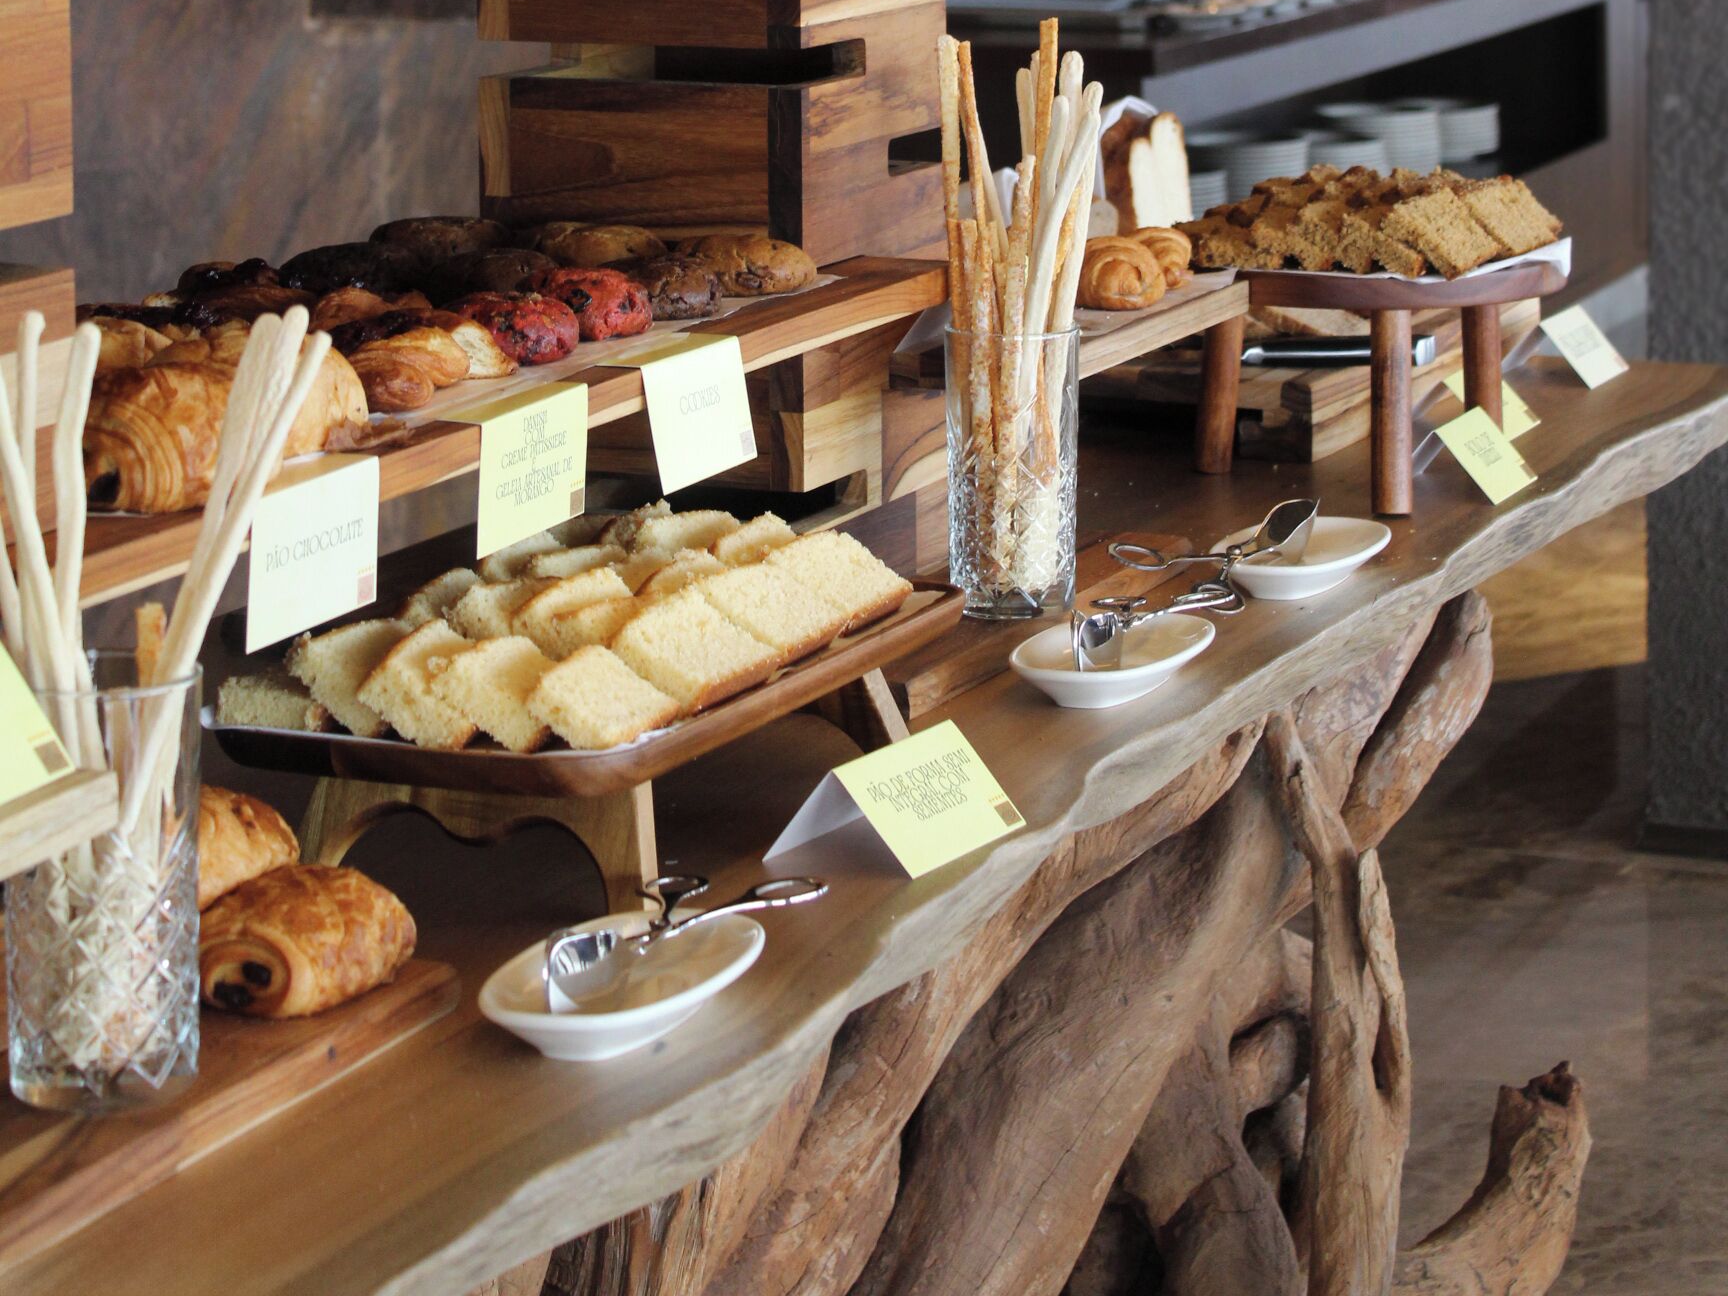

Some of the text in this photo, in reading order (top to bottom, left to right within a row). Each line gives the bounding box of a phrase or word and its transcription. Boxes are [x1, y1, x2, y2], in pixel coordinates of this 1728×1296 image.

[680, 385, 721, 415] COOKIES
[523, 410, 548, 434] DANISH
[501, 446, 528, 469] CREME
[495, 455, 573, 500] GELEIA ARTESANAL DE
[514, 477, 555, 507] MORANGO
[292, 517, 365, 561] CHOCOLATE
[866, 748, 971, 803] PÃO DE FORMA SEMI
[889, 764, 971, 813] INTEGRAL COM
[912, 786, 968, 821] SEMENTES
